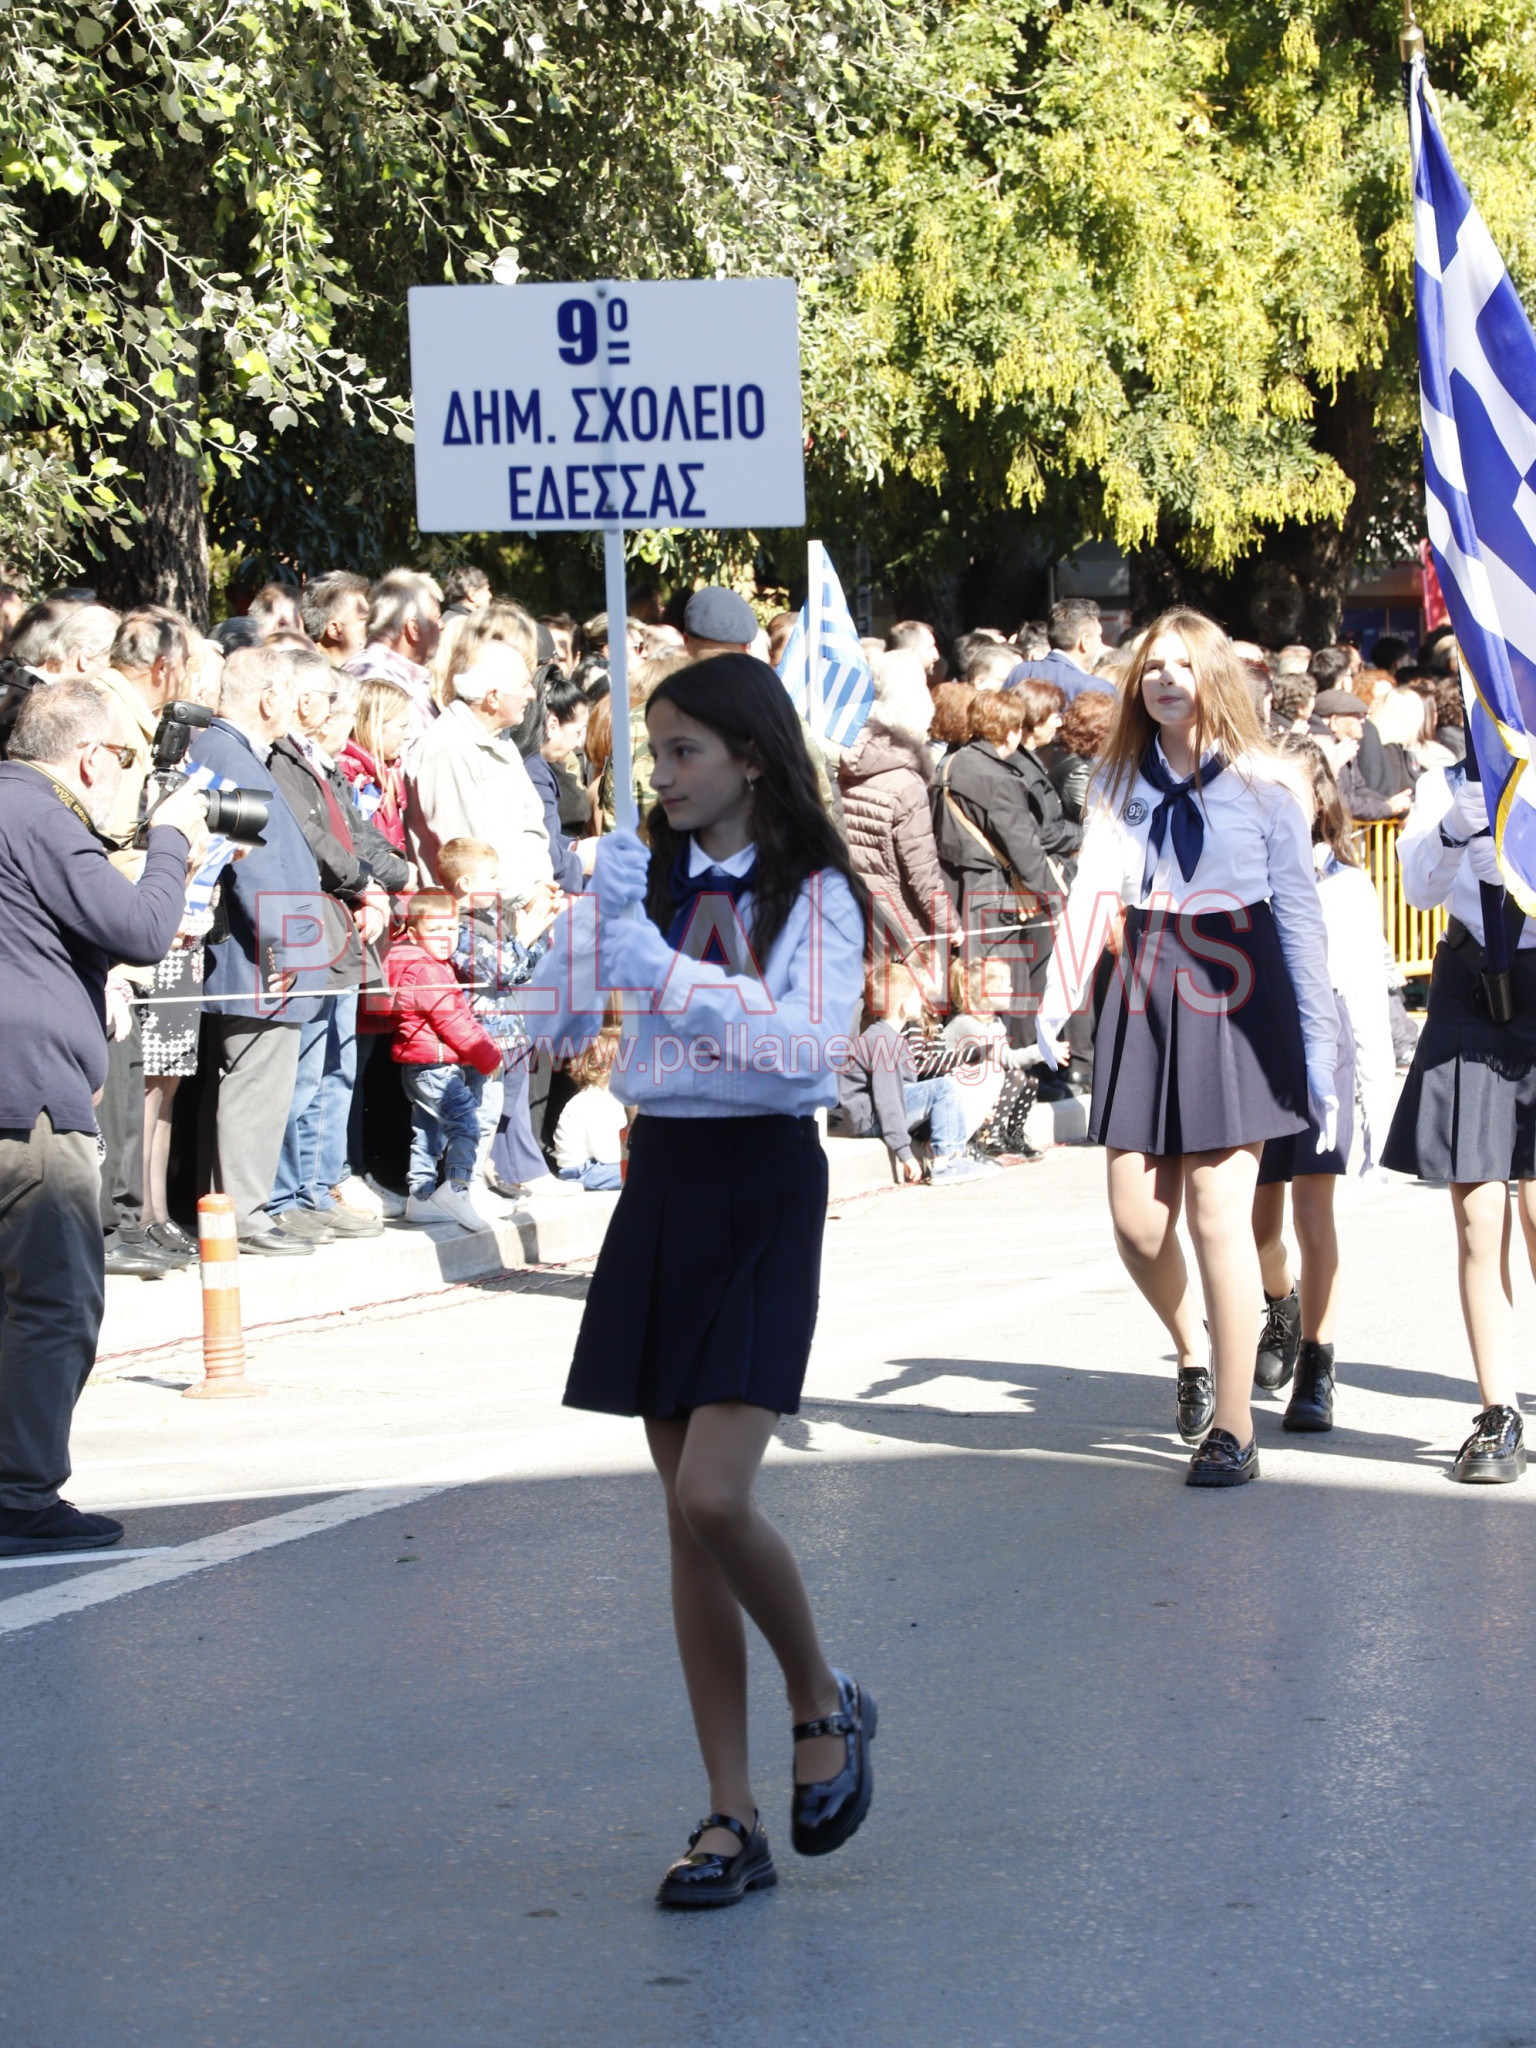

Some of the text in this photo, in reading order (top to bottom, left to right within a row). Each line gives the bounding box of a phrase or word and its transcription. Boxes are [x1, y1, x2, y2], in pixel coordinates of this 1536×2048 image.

[443, 384, 765, 446] ΔΗΜ. ΣΧΟΛΕΙΟ
[508, 463, 706, 521] ΕΔΕΣΣΑΣ
